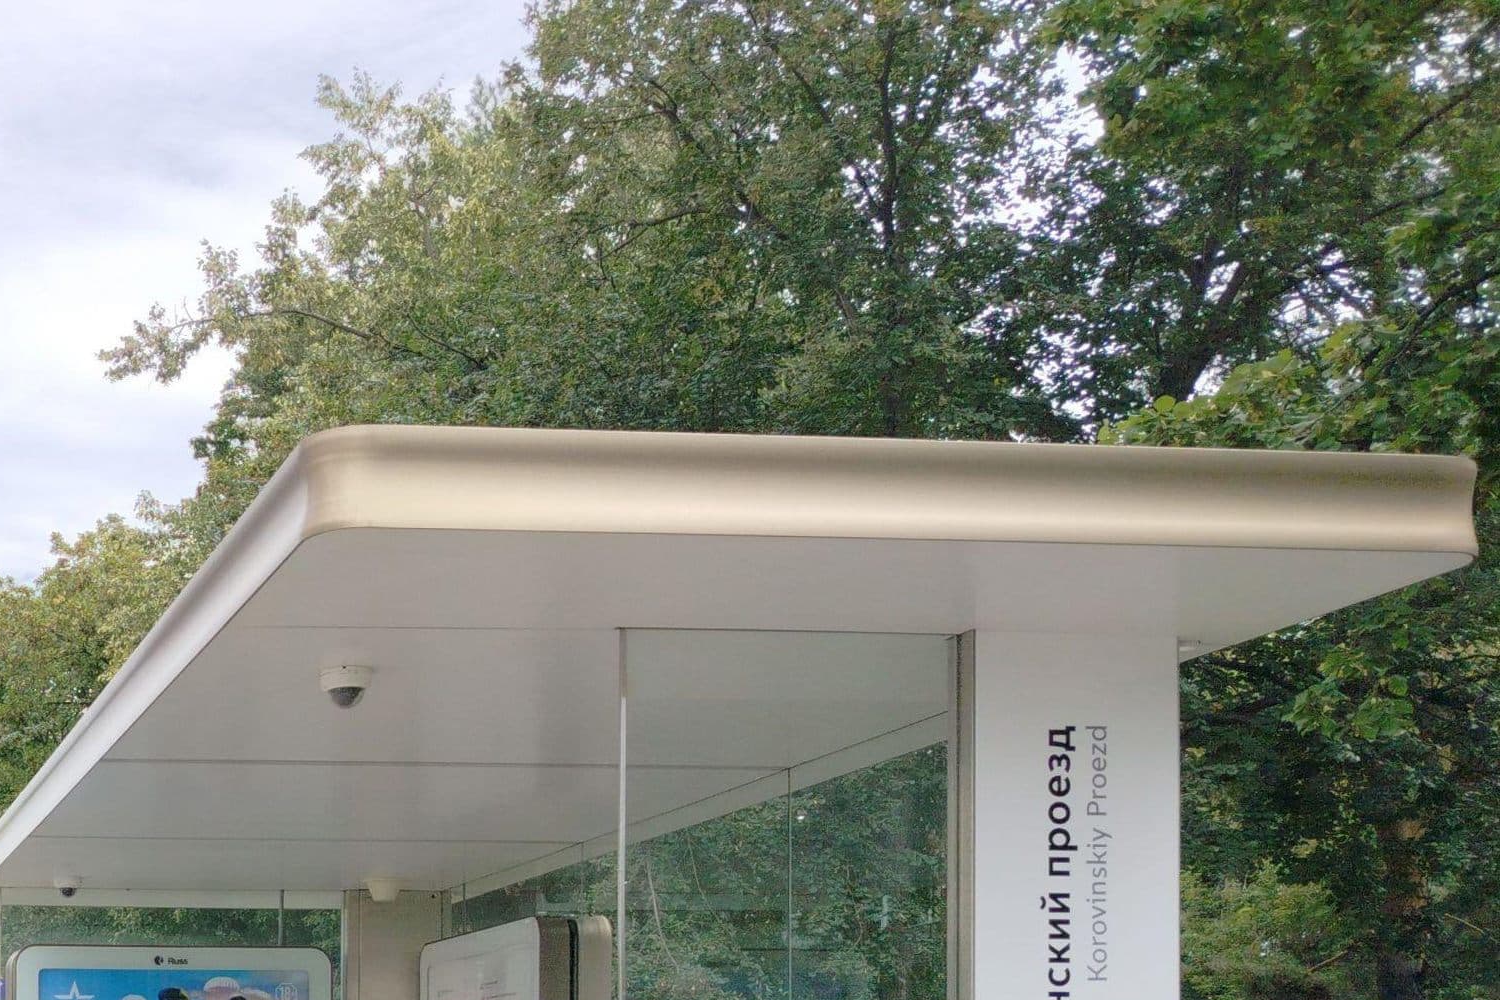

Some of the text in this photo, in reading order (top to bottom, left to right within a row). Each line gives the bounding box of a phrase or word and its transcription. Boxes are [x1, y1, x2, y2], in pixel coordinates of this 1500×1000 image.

[1048, 726, 1078, 876] проезд
[1085, 726, 1113, 981] Korovinskiy Proezd
